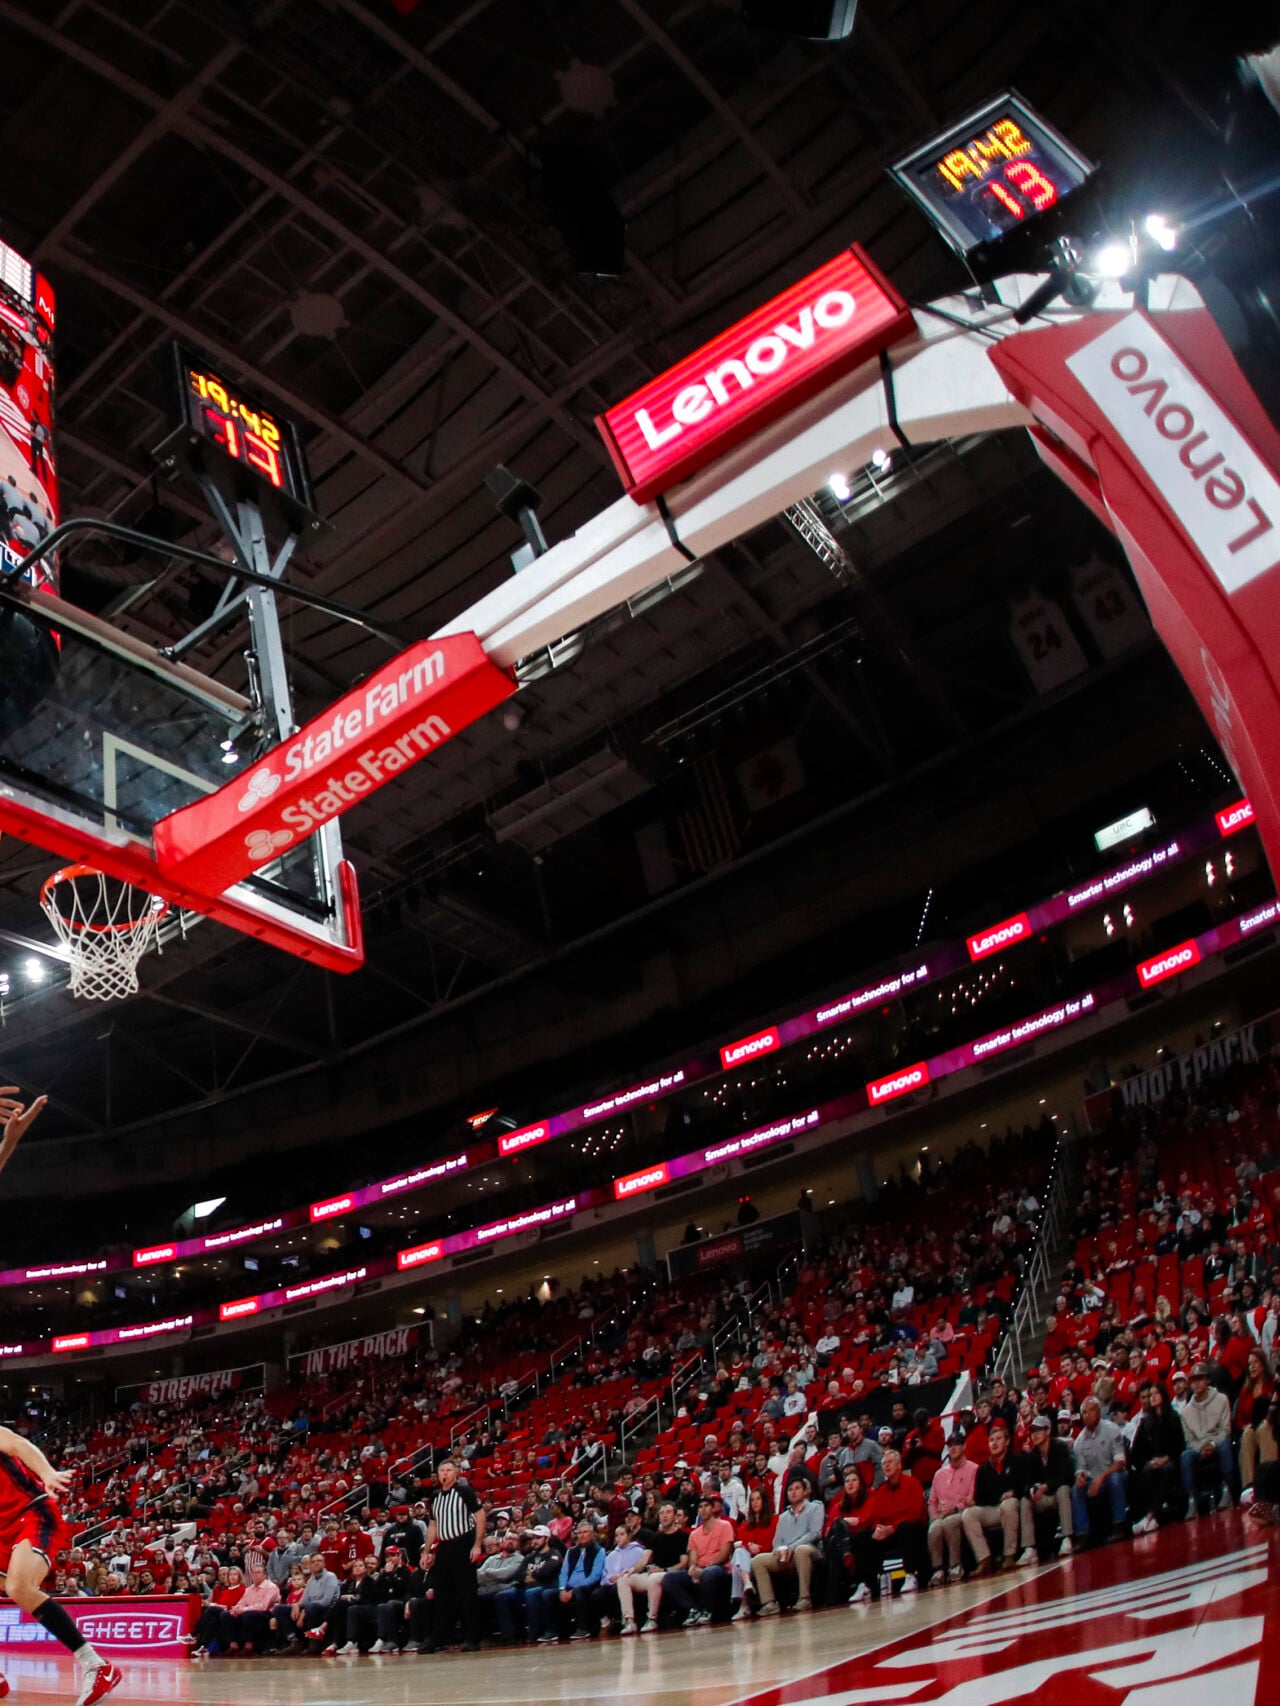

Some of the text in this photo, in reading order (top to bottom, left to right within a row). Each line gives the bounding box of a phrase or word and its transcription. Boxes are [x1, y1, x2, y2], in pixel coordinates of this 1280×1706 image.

[937, 118, 1033, 193] 19:42
[984, 159, 1058, 221] 13
[634, 290, 856, 450] Lenovo
[190, 371, 280, 452] 19:42
[1109, 346, 1274, 555] Lenovo
[1027, 623, 1062, 660] 24
[1220, 804, 1253, 829] Leno
[1067, 842, 1179, 906] Smarter technology for all
[1239, 906, 1276, 931] Smarter
[972, 922, 1023, 954] Lenovo
[1142, 949, 1192, 980] Lenovo
[816, 965, 928, 1022] Smarter technology for all
[973, 993, 1094, 1056] Smarter technology for all
[724, 1035, 773, 1063] Lenovo
[583, 1070, 684, 1118] Smarter technology for all
[871, 1071, 922, 1099] Lenovo
[502, 1127, 545, 1150] Lenovo
[704, 1110, 819, 1161] Smarter technology for all
[381, 1155, 467, 1193] Smarter technology for all
[618, 1170, 664, 1194] Lenovo
[313, 1198, 351, 1217] Lenovo
[477, 1199, 576, 1240] Smarter technology for all
[204, 1218, 282, 1247] Smarter technology for all
[136, 1248, 173, 1263] Lenovo
[401, 1246, 439, 1265] Lenovo
[699, 1242, 737, 1261] Lenovo
[25, 1260, 107, 1278] Smarter technology for all
[286, 1267, 366, 1299] Smarter technology for all
[222, 1301, 256, 1317] Lenovo
[118, 1315, 193, 1338] Smarter technology for all
[3, 1346, 14, 1354] for
[13, 1344, 23, 1353] all
[55, 1337, 87, 1349] Lenovo
[306, 1329, 409, 1376] IN THE PACK
[148, 1371, 232, 1402] STRENGTH
[82, 1620, 174, 1640] SHEETZ
